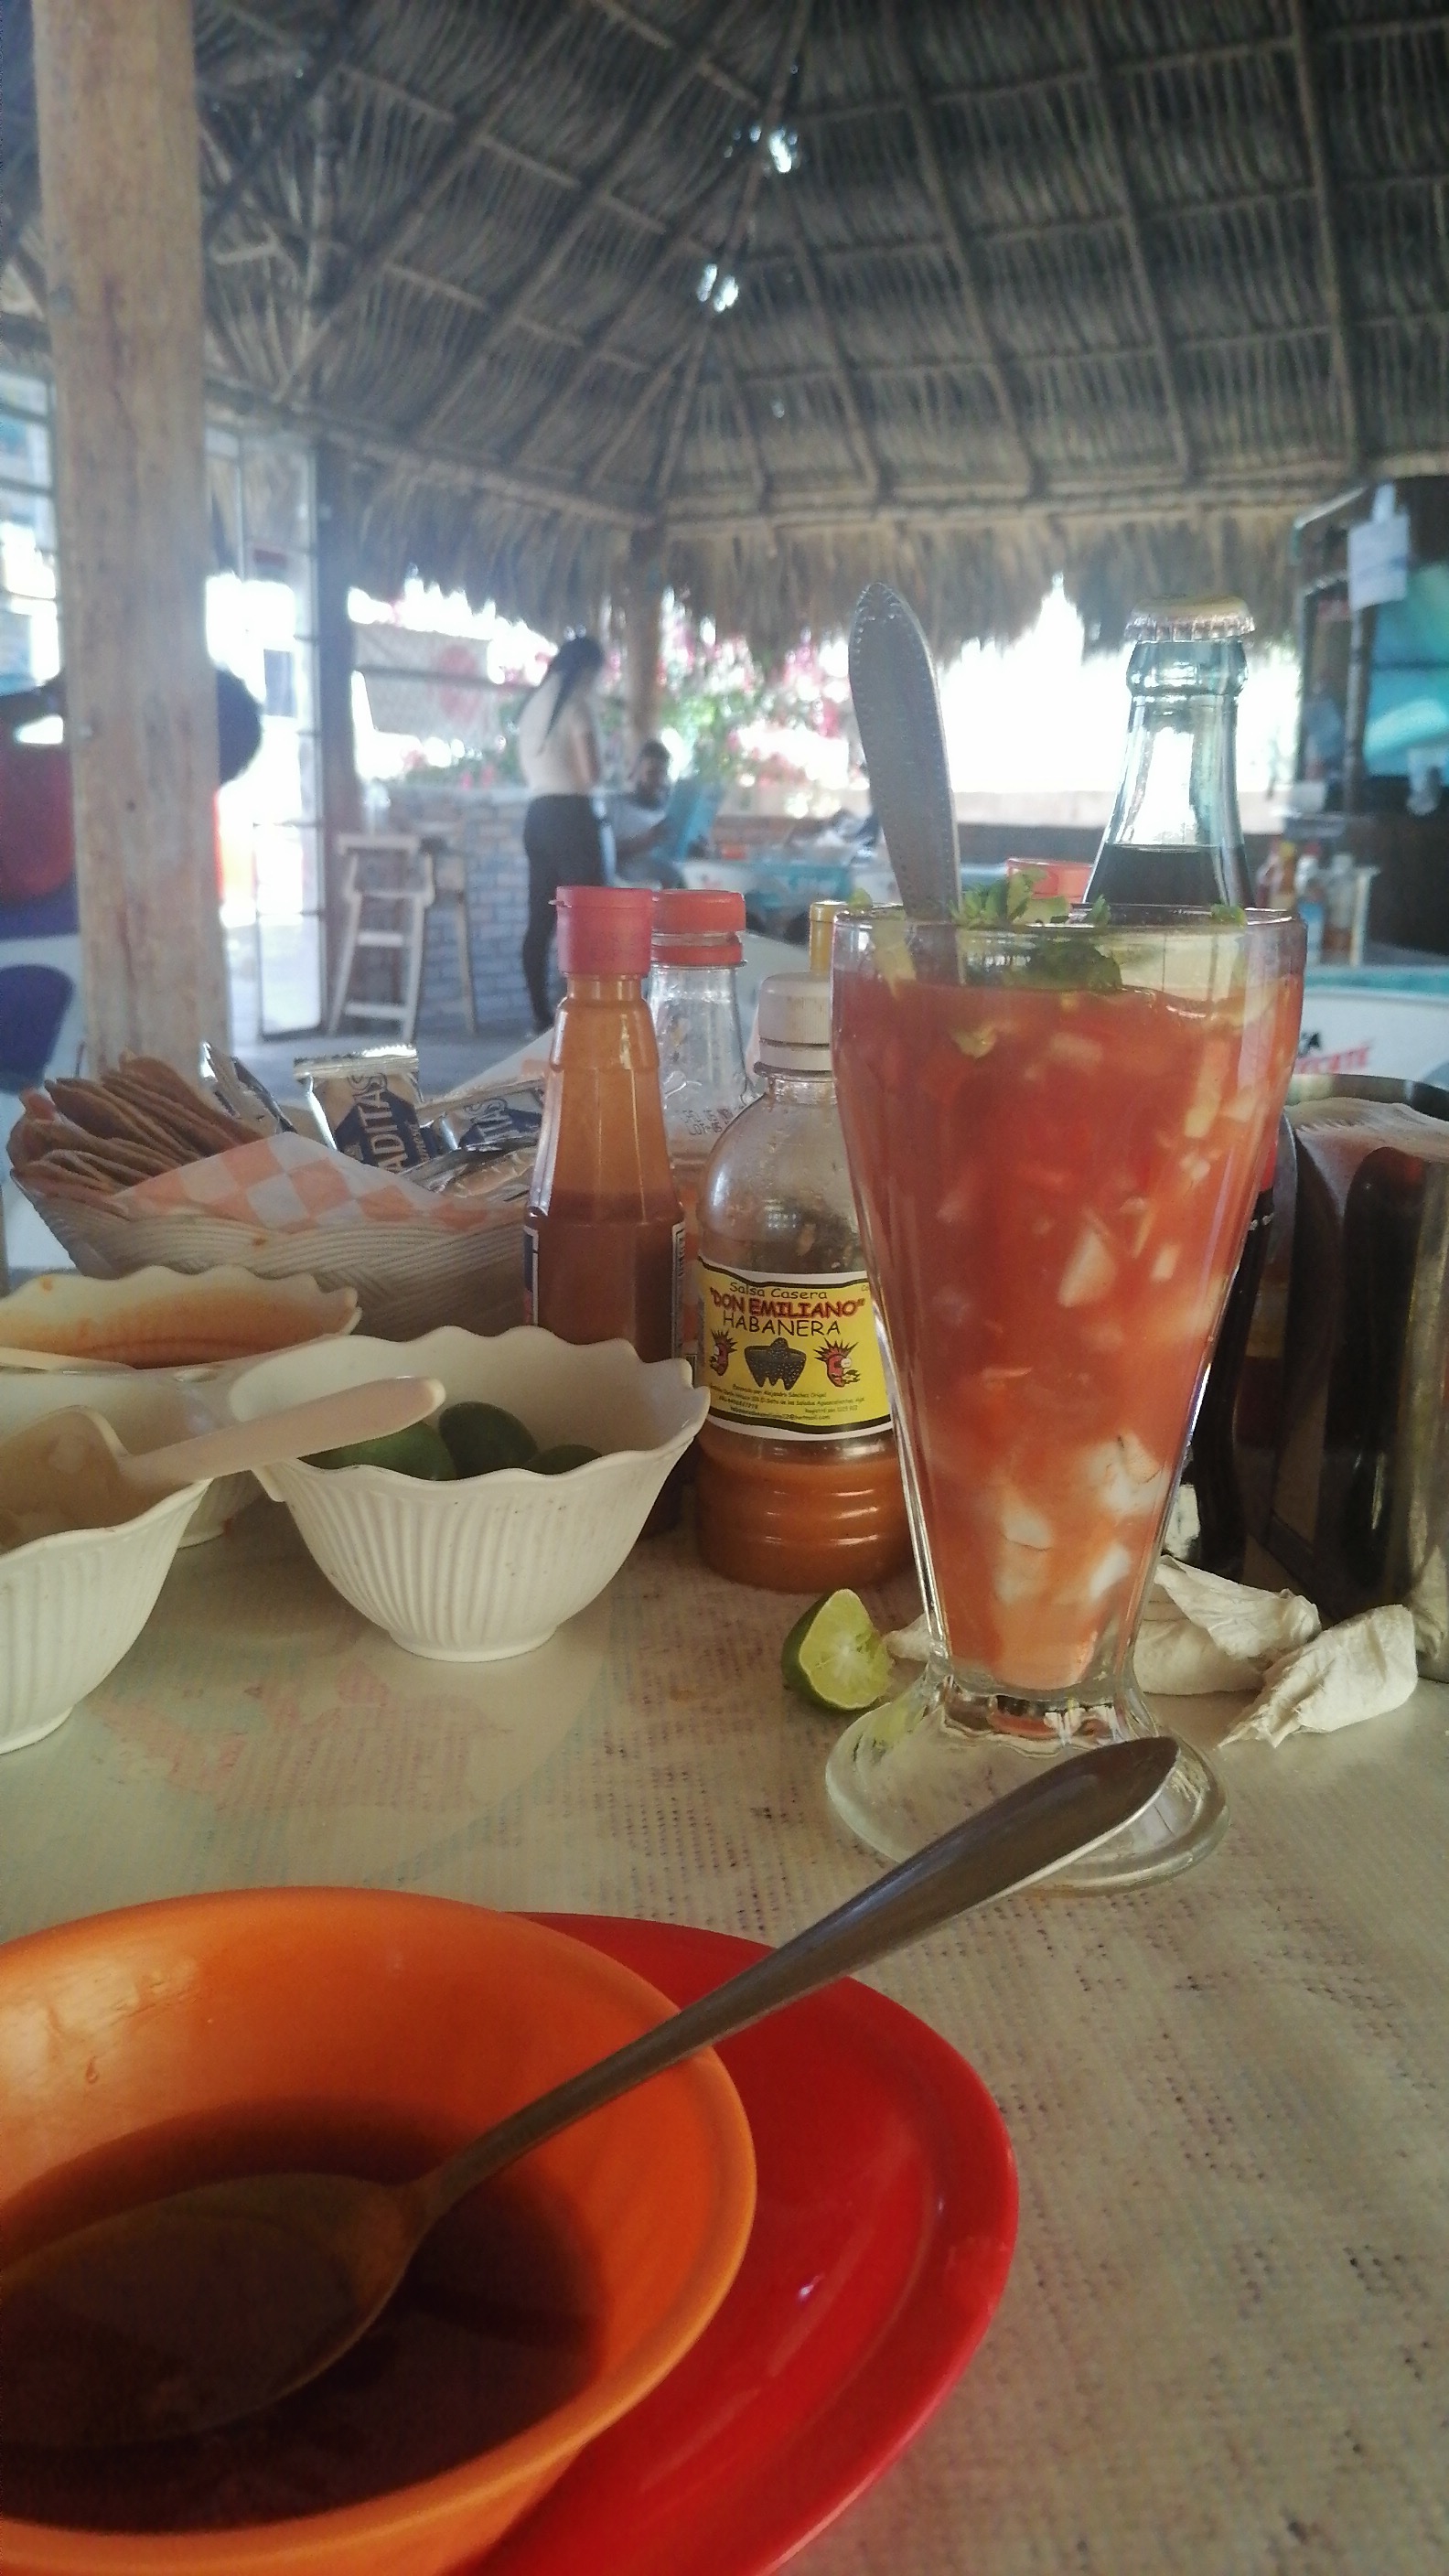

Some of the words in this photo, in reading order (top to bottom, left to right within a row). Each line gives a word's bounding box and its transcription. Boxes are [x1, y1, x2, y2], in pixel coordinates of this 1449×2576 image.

[730, 1283, 766, 1297] Salsa
[770, 1288, 828, 1300] Casera
[723, 1310, 842, 1337] HABANERA
